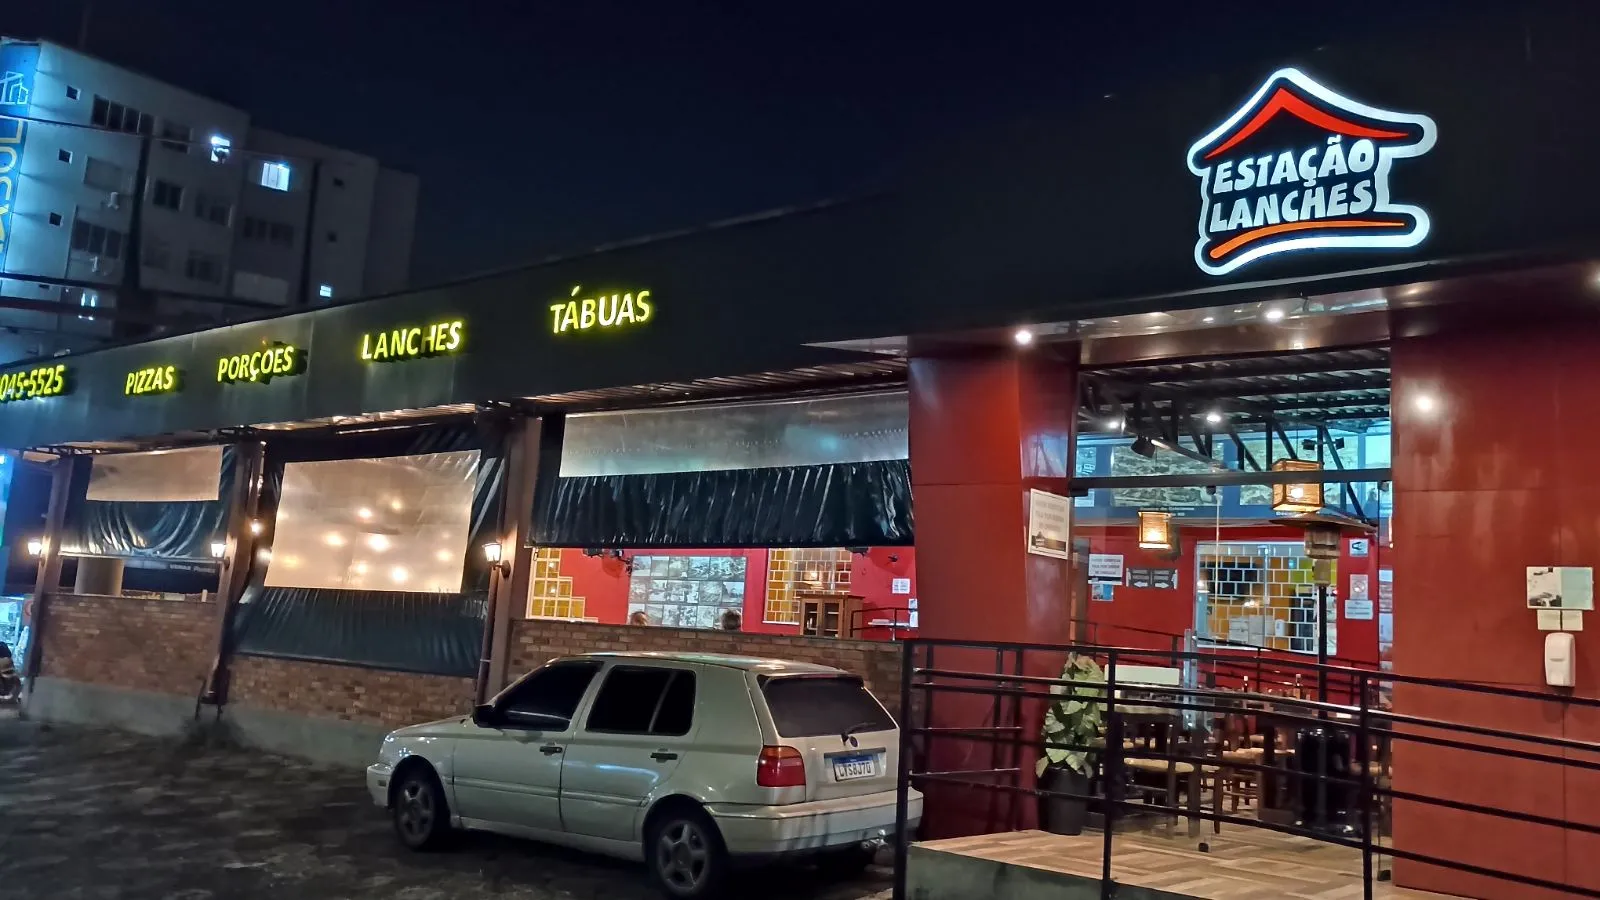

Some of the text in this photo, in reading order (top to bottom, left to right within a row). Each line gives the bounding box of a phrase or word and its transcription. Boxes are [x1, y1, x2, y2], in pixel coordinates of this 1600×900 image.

[1212, 135, 1375, 194] ESTAÇÃO
[1209, 180, 1373, 232] LANCHES
[550, 286, 650, 333] TÁBUAS
[361, 321, 462, 359] LANCHES
[125, 366, 174, 394] PIZZAS
